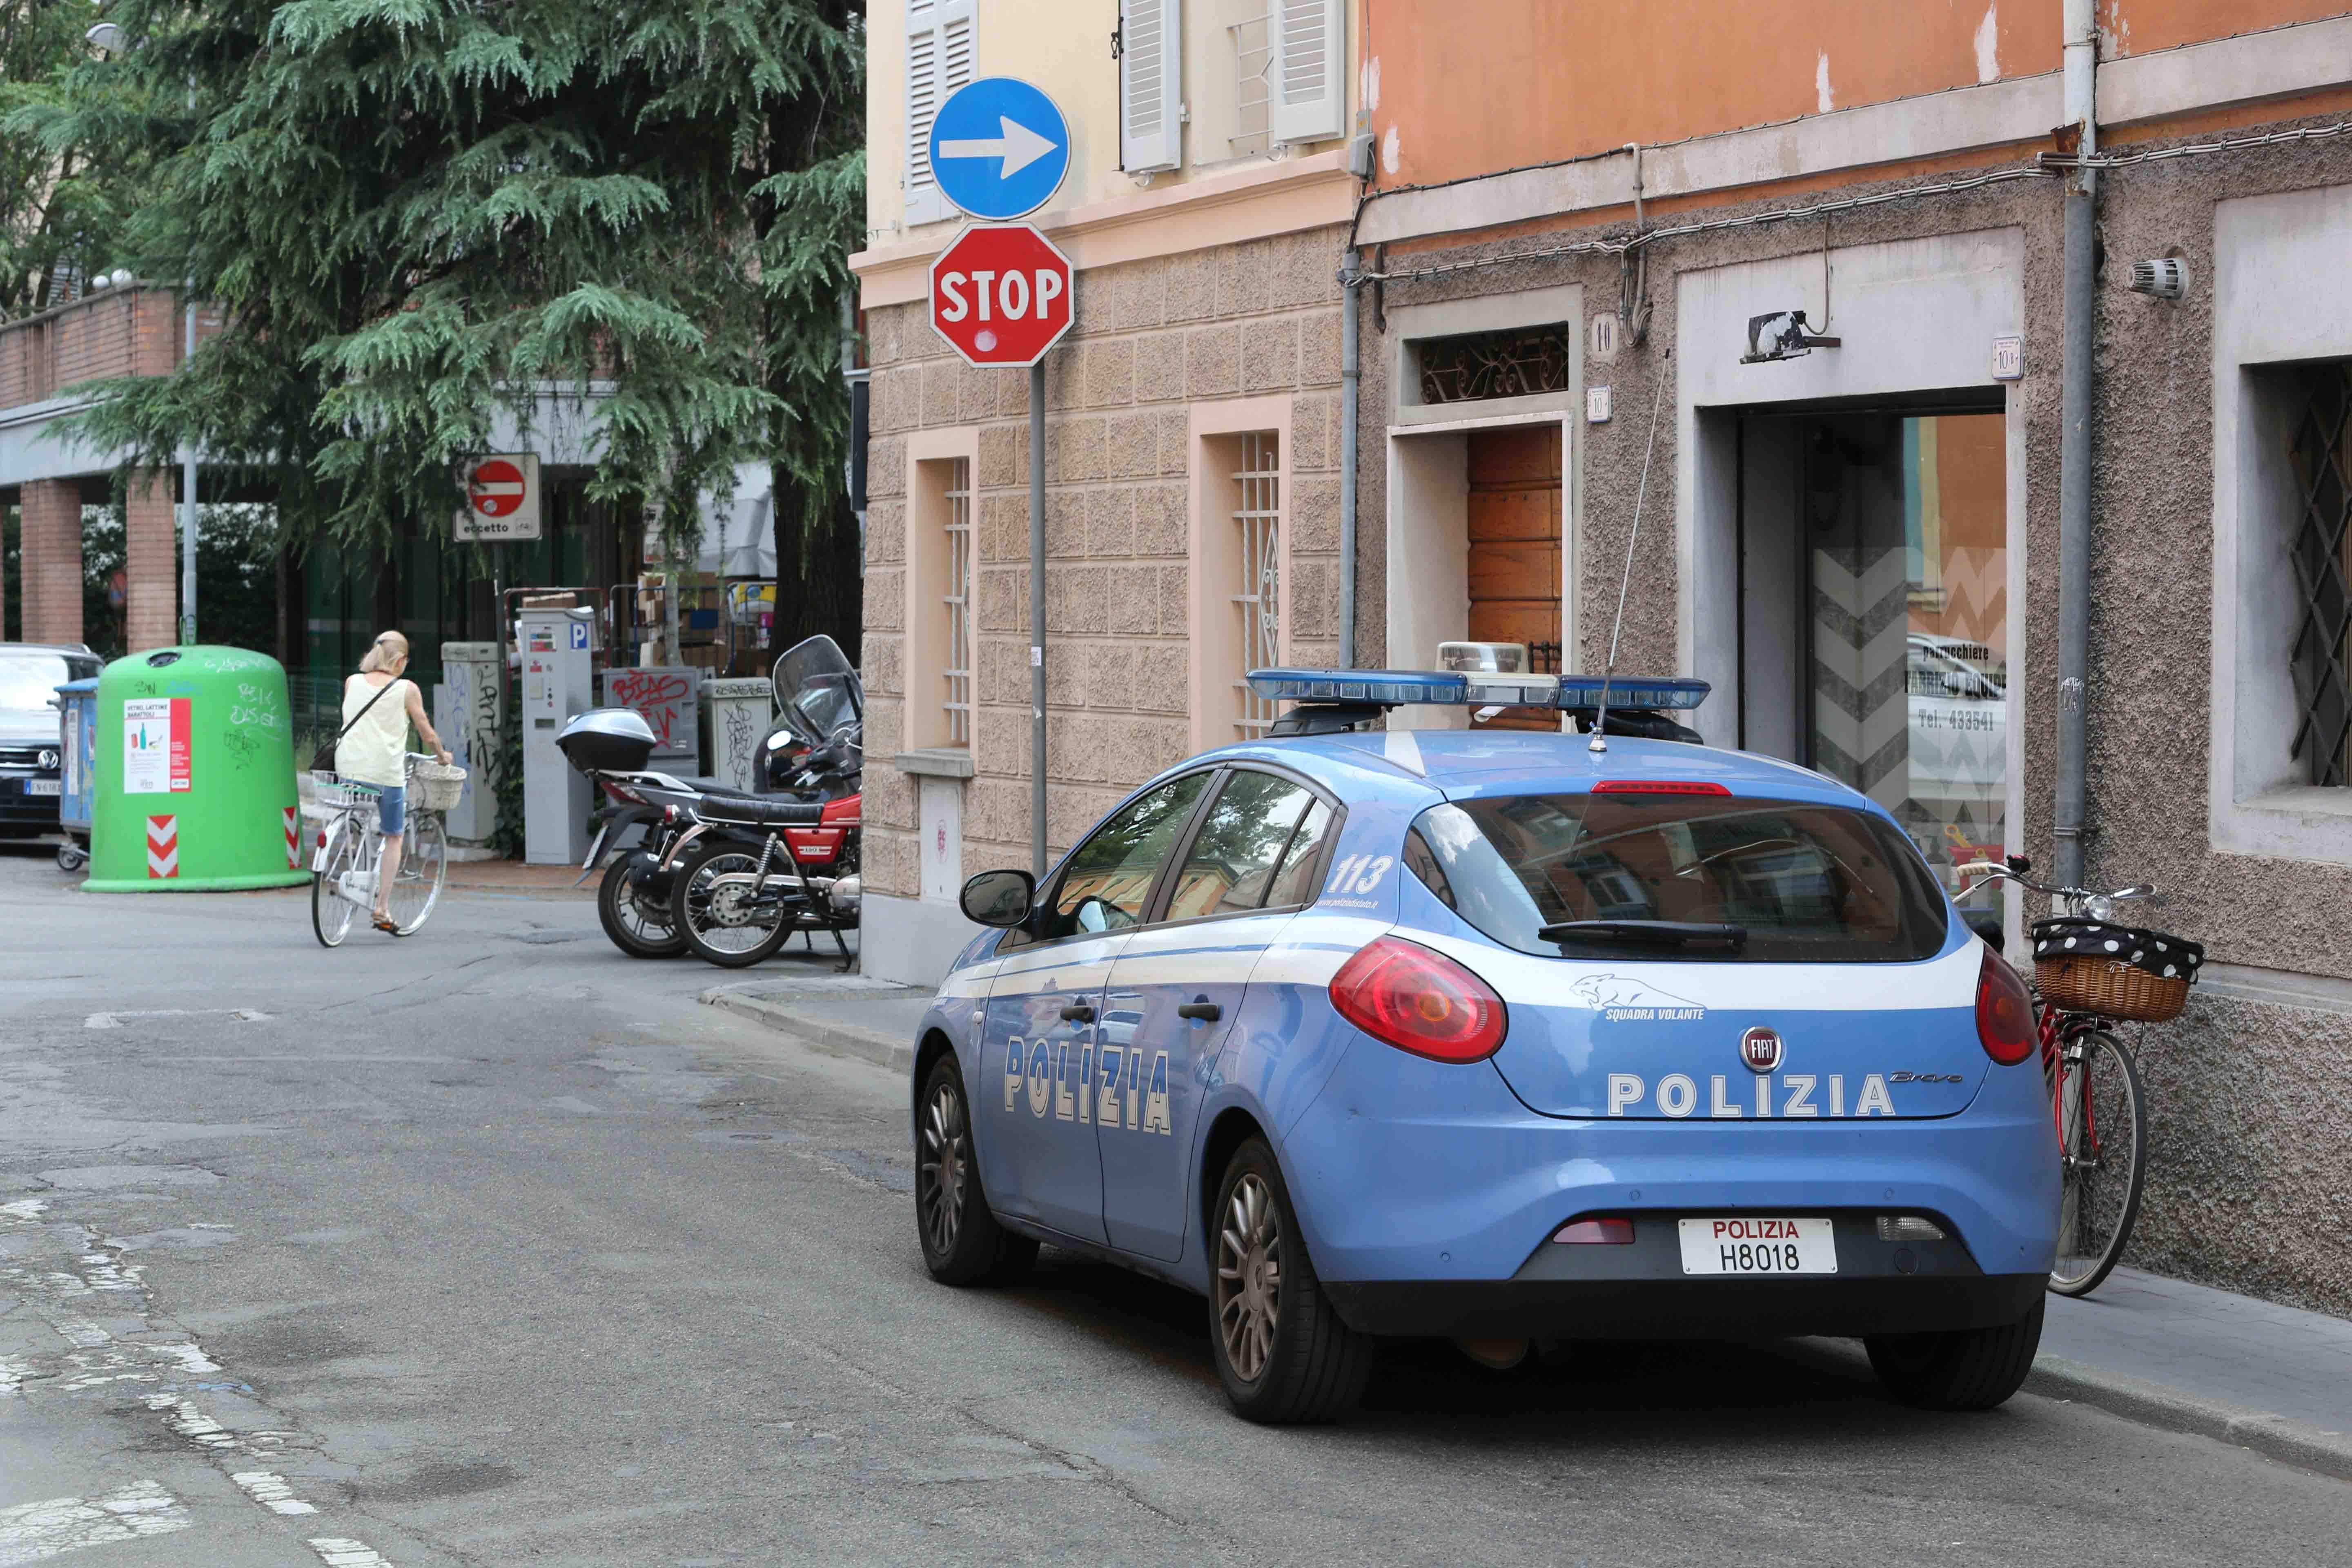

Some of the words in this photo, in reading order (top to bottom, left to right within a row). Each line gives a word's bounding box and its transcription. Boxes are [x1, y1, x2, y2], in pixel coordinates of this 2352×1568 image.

[940, 269, 1062, 322] STOP
[1594, 397, 1602, 413] 10
[463, 523, 509, 533] eccetto
[573, 624, 586, 648] P
[1923, 644, 1989, 662] parrucchiere
[1918, 708, 1942, 729] Tel.
[1949, 710, 1993, 731] 433541
[1327, 853, 1393, 894] 113
[1317, 899, 1379, 909] www.poliziadistato.it
[1606, 1009, 1654, 1022] SQUADRA
[1658, 1009, 1705, 1020] VOLANTE
[1751, 1039, 1774, 1059] FIAT
[1004, 1036, 1171, 1136] POLIZIA
[1889, 1071, 1963, 1083] Bravo
[1608, 1074, 1896, 1118] POLIZIA
[1713, 1221, 1800, 1239] POLIZIA
[1720, 1244, 1800, 1271] H8018
